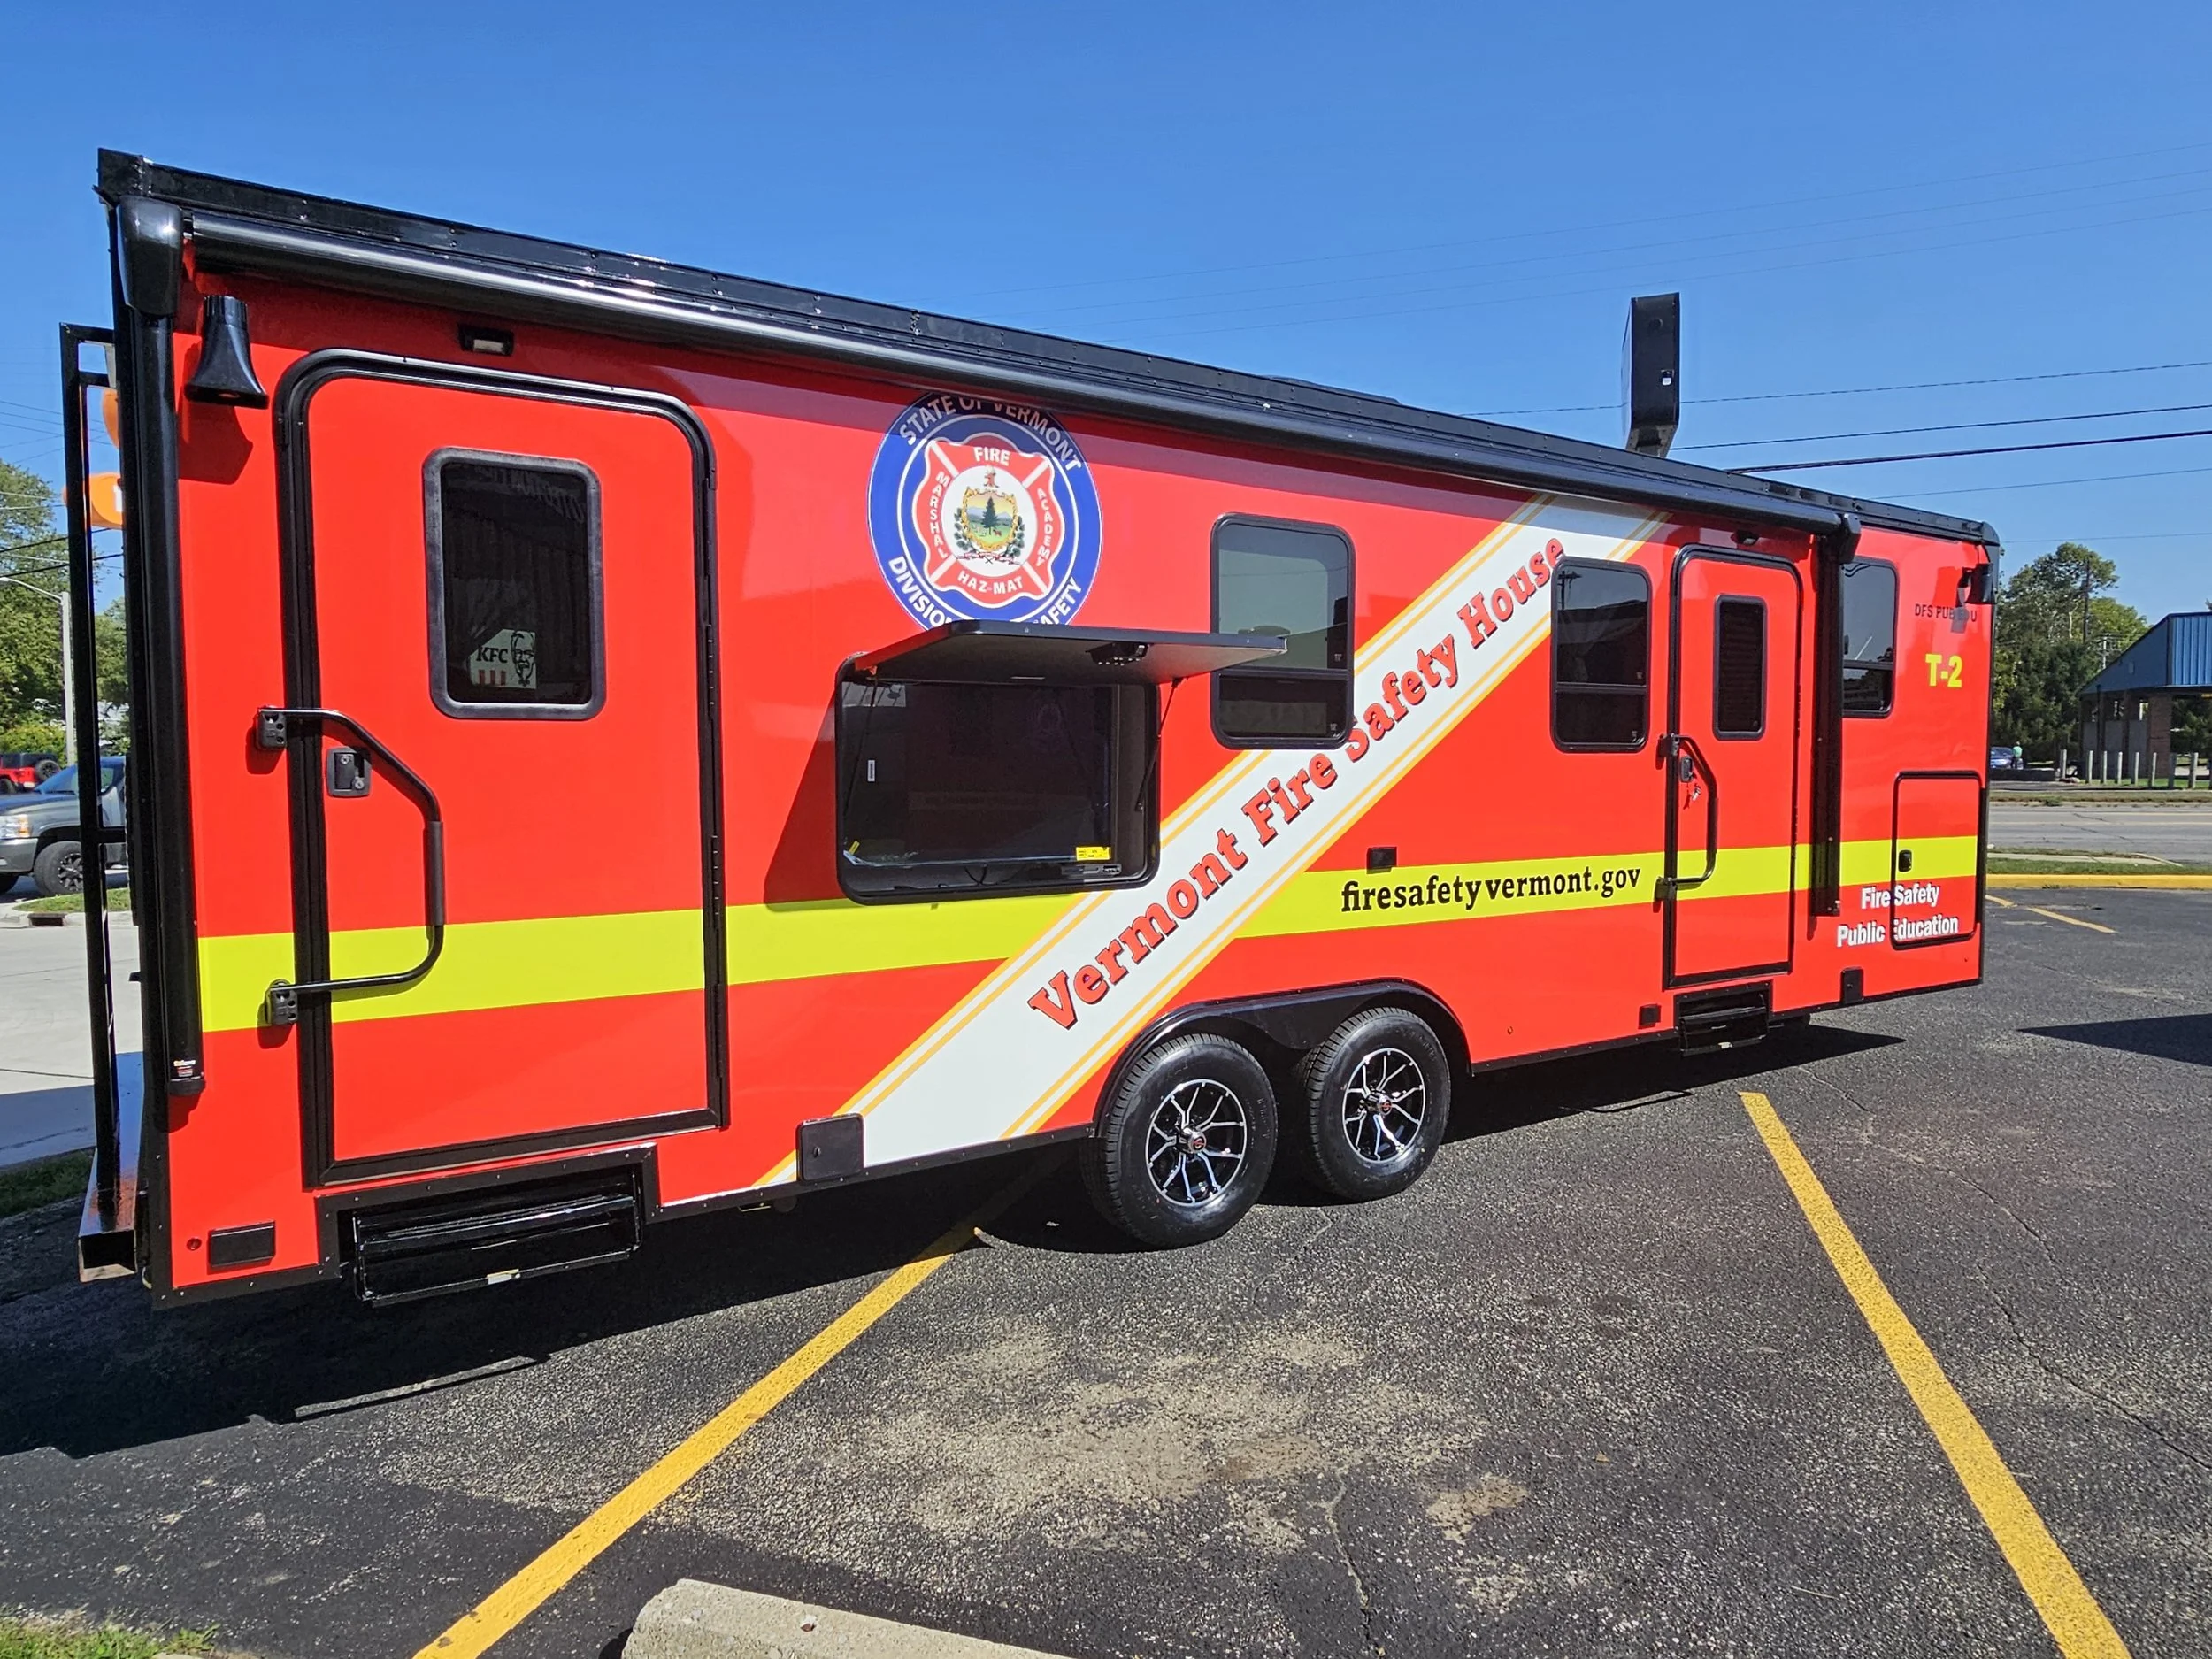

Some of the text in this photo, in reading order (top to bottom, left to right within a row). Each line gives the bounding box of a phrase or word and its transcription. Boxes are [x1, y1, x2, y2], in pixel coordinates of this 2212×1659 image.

[899, 396, 956, 446] STATE
[974, 447, 1010, 466] FIRE
[929, 471, 951, 559] MARSHAL
[1036, 488, 1054, 567] ACADEMY
[888, 556, 1082, 627] DIVISIO AFETY
[957, 570, 1024, 595] HAZ-MAT
[1915, 603, 1933, 618] DFS
[476, 646, 508, 664] KFC
[1925, 654, 1962, 687] T-2
[1027, 828, 1248, 1030] Vermont
[1241, 753, 1338, 847] Fire
[1457, 538, 1565, 649] House
[1341, 865, 1641, 912] firesafetyvermont.gov
[1861, 882, 1939, 909] Fire Safety
[1837, 920, 1886, 948] Public
